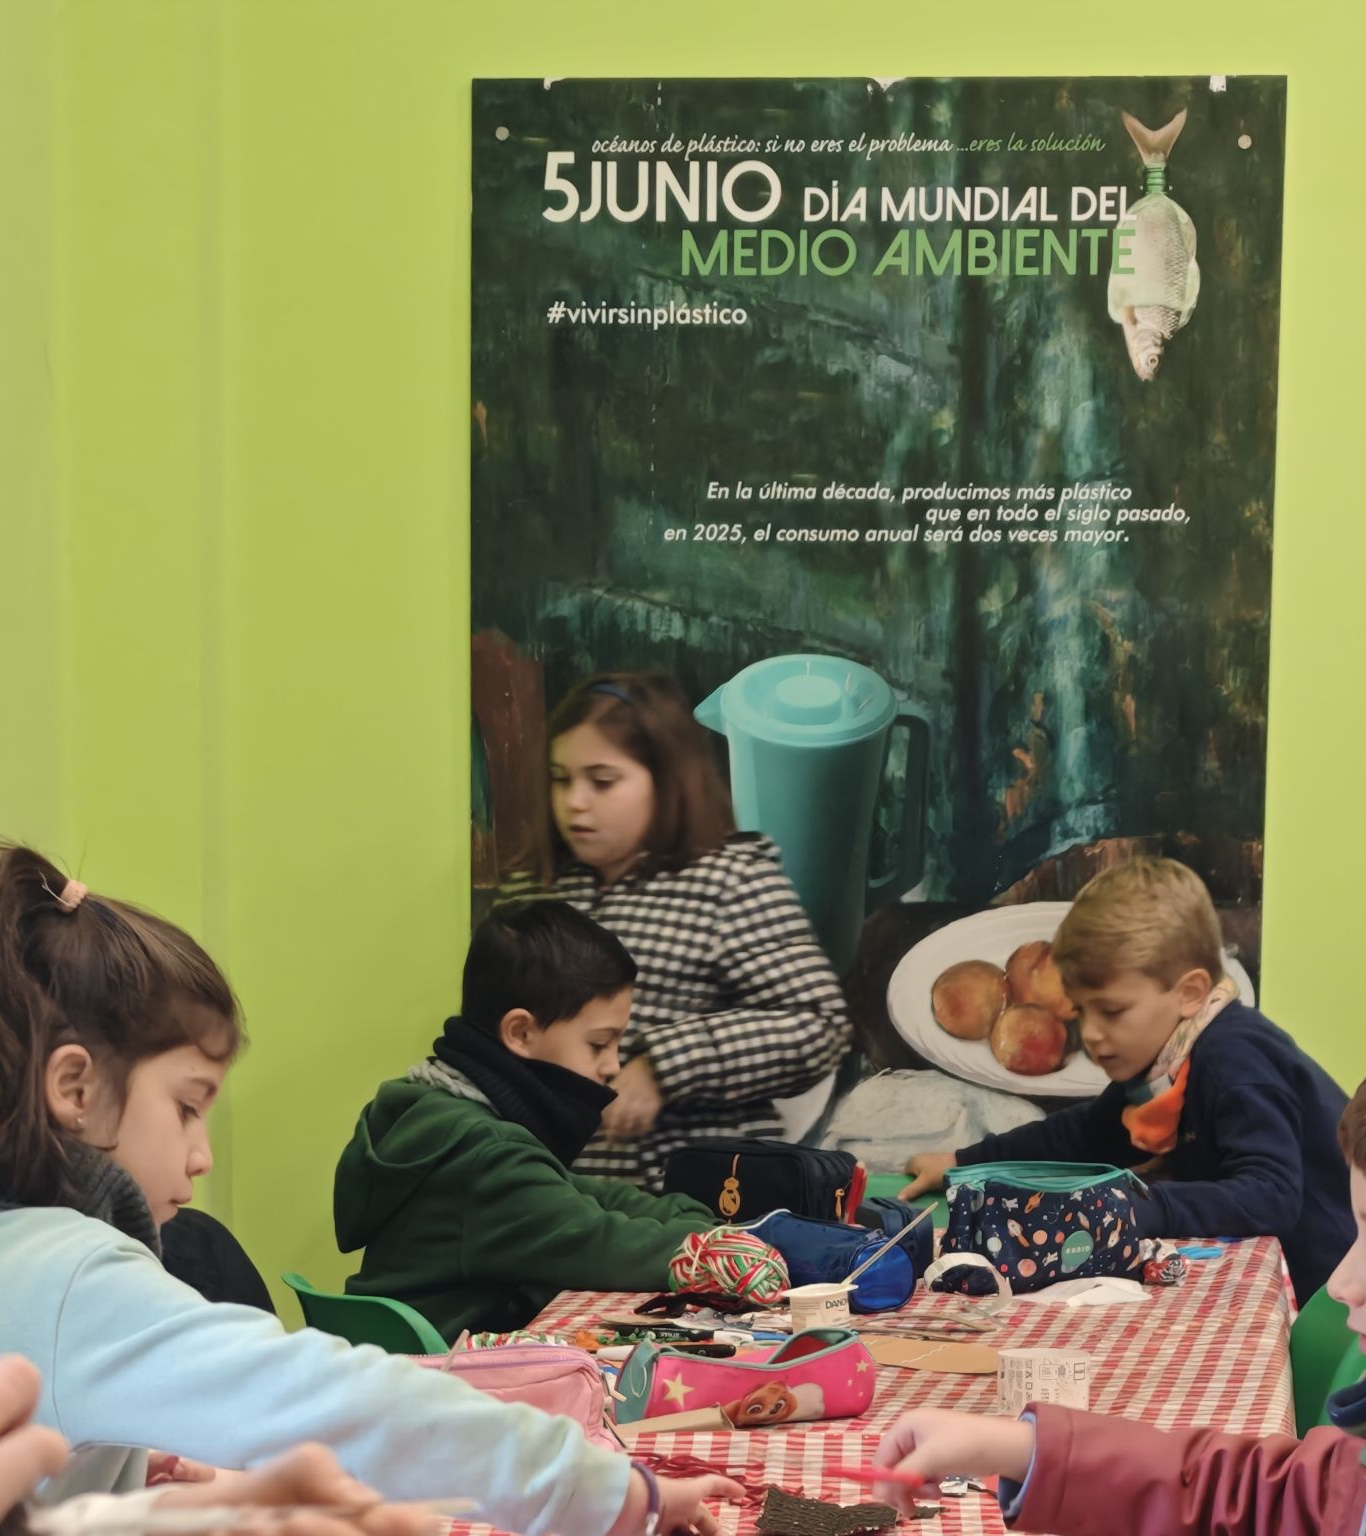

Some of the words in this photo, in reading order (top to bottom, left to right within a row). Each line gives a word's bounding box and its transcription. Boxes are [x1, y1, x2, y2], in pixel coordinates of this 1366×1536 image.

[591, 135, 657, 153] océanos
[661, 133, 685, 153] de
[685, 133, 761, 161] plástico:
[765, 135, 781, 153] si
[784, 139, 806, 153] no
[810, 139, 842, 152] eres
[848, 132, 868, 152] el
[866, 132, 955, 161] problema
[1007, 132, 1028, 152] la
[1030, 132, 1106, 152] solución
[542, 151, 782, 223] 5JUNIO
[803, 180, 867, 222] DÍA
[880, 186, 1058, 222] MUNDIAL
[1071, 186, 1137, 222] DEL
[681, 228, 858, 277] MEDIO
[872, 228, 1137, 277] AMBIENTE
[547, 301, 748, 331] #vivirsinplástico
[706, 481, 730, 500] En
[735, 481, 753, 500] la
[758, 481, 817, 500] última
[822, 481, 896, 503] década,
[901, 482, 1011, 506] producimos
[1016, 483, 1055, 501] más
[1059, 482, 1133, 506] plástico
[925, 505, 962, 525] que
[966, 507, 991, 522] en
[996, 503, 1039, 522] todo
[1044, 503, 1062, 522] el
[1067, 503, 1112, 526] siglo
[1115, 503, 1191, 525] pasado,
[663, 527, 687, 542] en
[692, 523, 747, 544] 2025,
[753, 523, 772, 542] el
[776, 527, 860, 542] consumo
[864, 524, 920, 542] anual
[923, 525, 964, 543] será
[969, 525, 1003, 543] dos
[1008, 529, 1058, 543] veces
[1063, 528, 1130, 547] mayor.
